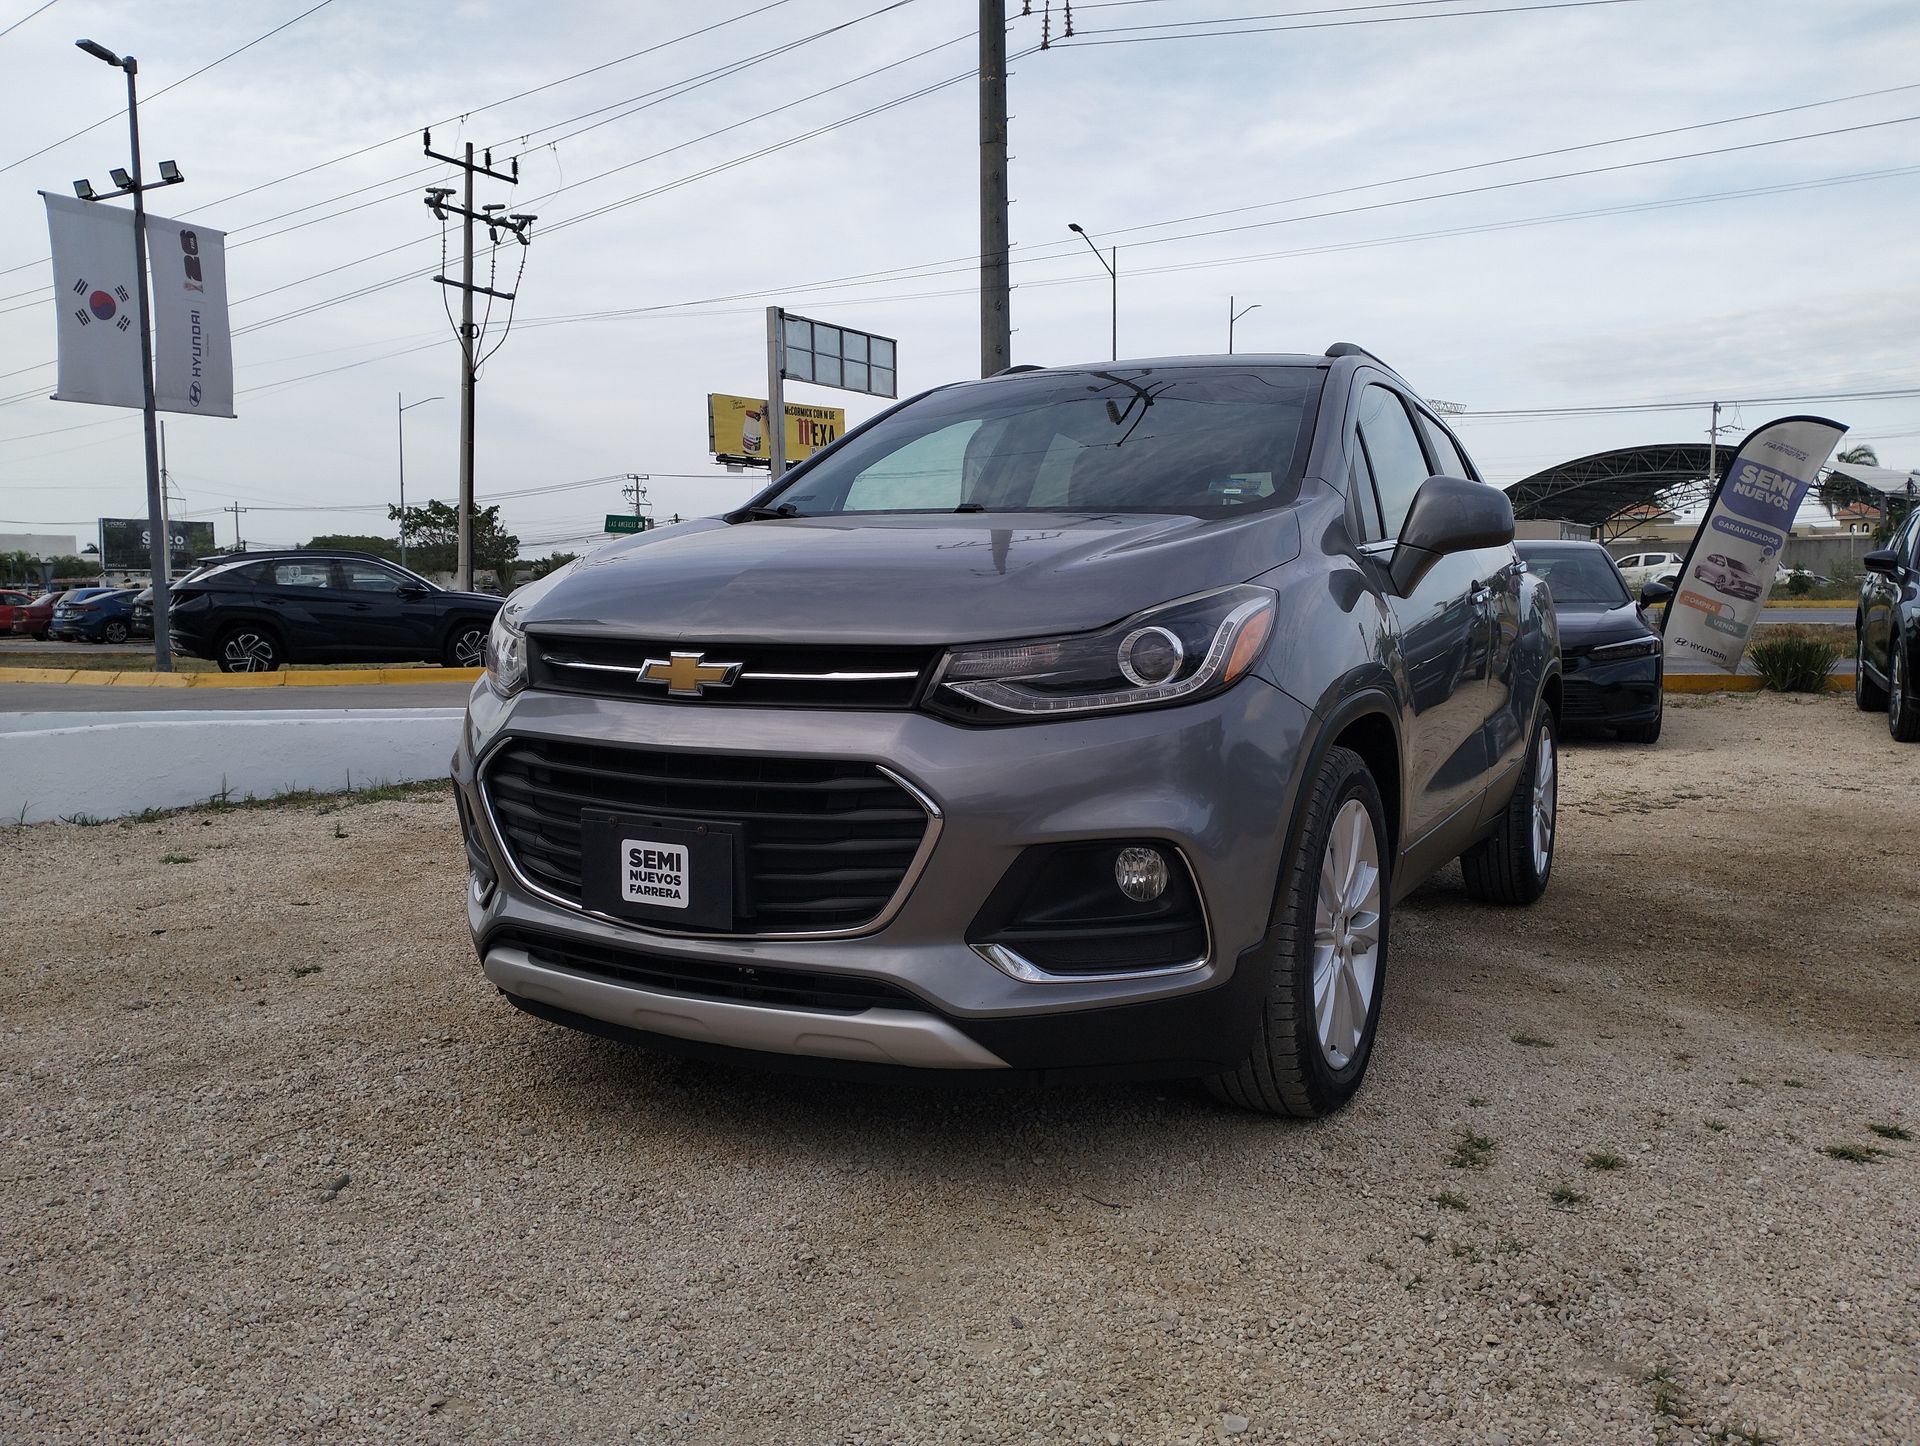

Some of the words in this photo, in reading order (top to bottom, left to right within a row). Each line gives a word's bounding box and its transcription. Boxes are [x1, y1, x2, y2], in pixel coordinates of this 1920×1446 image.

[191, 309, 202, 377] HYUNDAI
[813, 409, 823, 419] CON
[829, 411, 835, 420] DE
[1739, 465, 1797, 500] SEMI
[1733, 482, 1789, 511] NUEVOS
[1718, 520, 1778, 545] GARANTIZADOS
[1684, 595, 1716, 612] COMPRA
[1690, 641, 1728, 661] HYUNDAI
[629, 848, 681, 872] SEMI
[630, 869, 681, 886] NUEVOS
[630, 884, 681, 900] FARRERA
